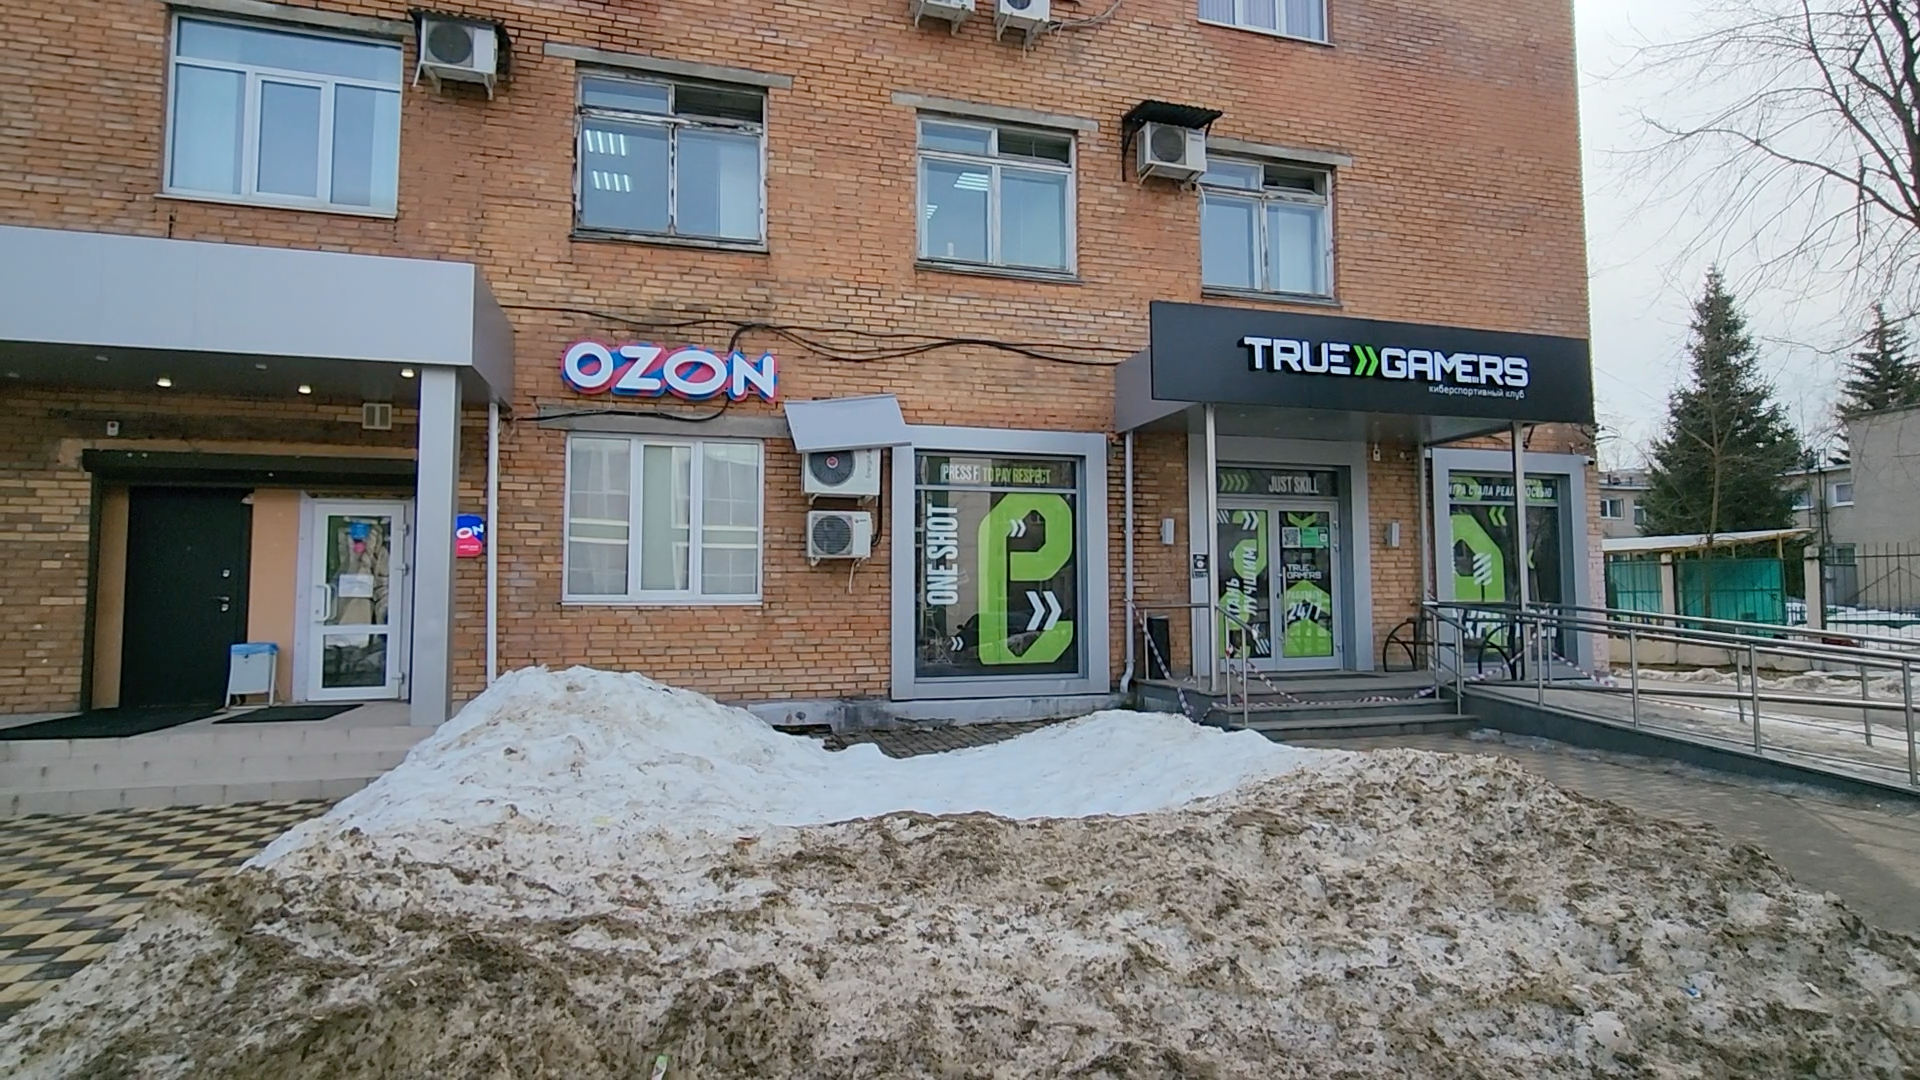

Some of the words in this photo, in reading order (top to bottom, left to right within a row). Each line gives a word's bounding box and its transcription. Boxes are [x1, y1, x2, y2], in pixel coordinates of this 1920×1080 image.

[563, 340, 776, 399] OZON
[1243, 336, 1350, 375] TRUE
[1380, 347, 1529, 387] GAMERS
[1428, 384, 1504, 397] киберспортивный
[1505, 389, 1525, 400] клуб
[942, 464, 972, 481] PRESS
[973, 465, 980, 482] F
[982, 467, 994, 482] TO
[995, 467, 1012, 483] PAY
[1012, 468, 1051, 484] RESPECT
[1269, 475, 1293, 493] JUST
[1294, 476, 1319, 494] SKILL
[926, 502, 958, 560] SHOT
[926, 563, 958, 605] ONE
[1242, 546, 1258, 616] ЛУЧШИМ
[1286, 564, 1310, 572] TRUE
